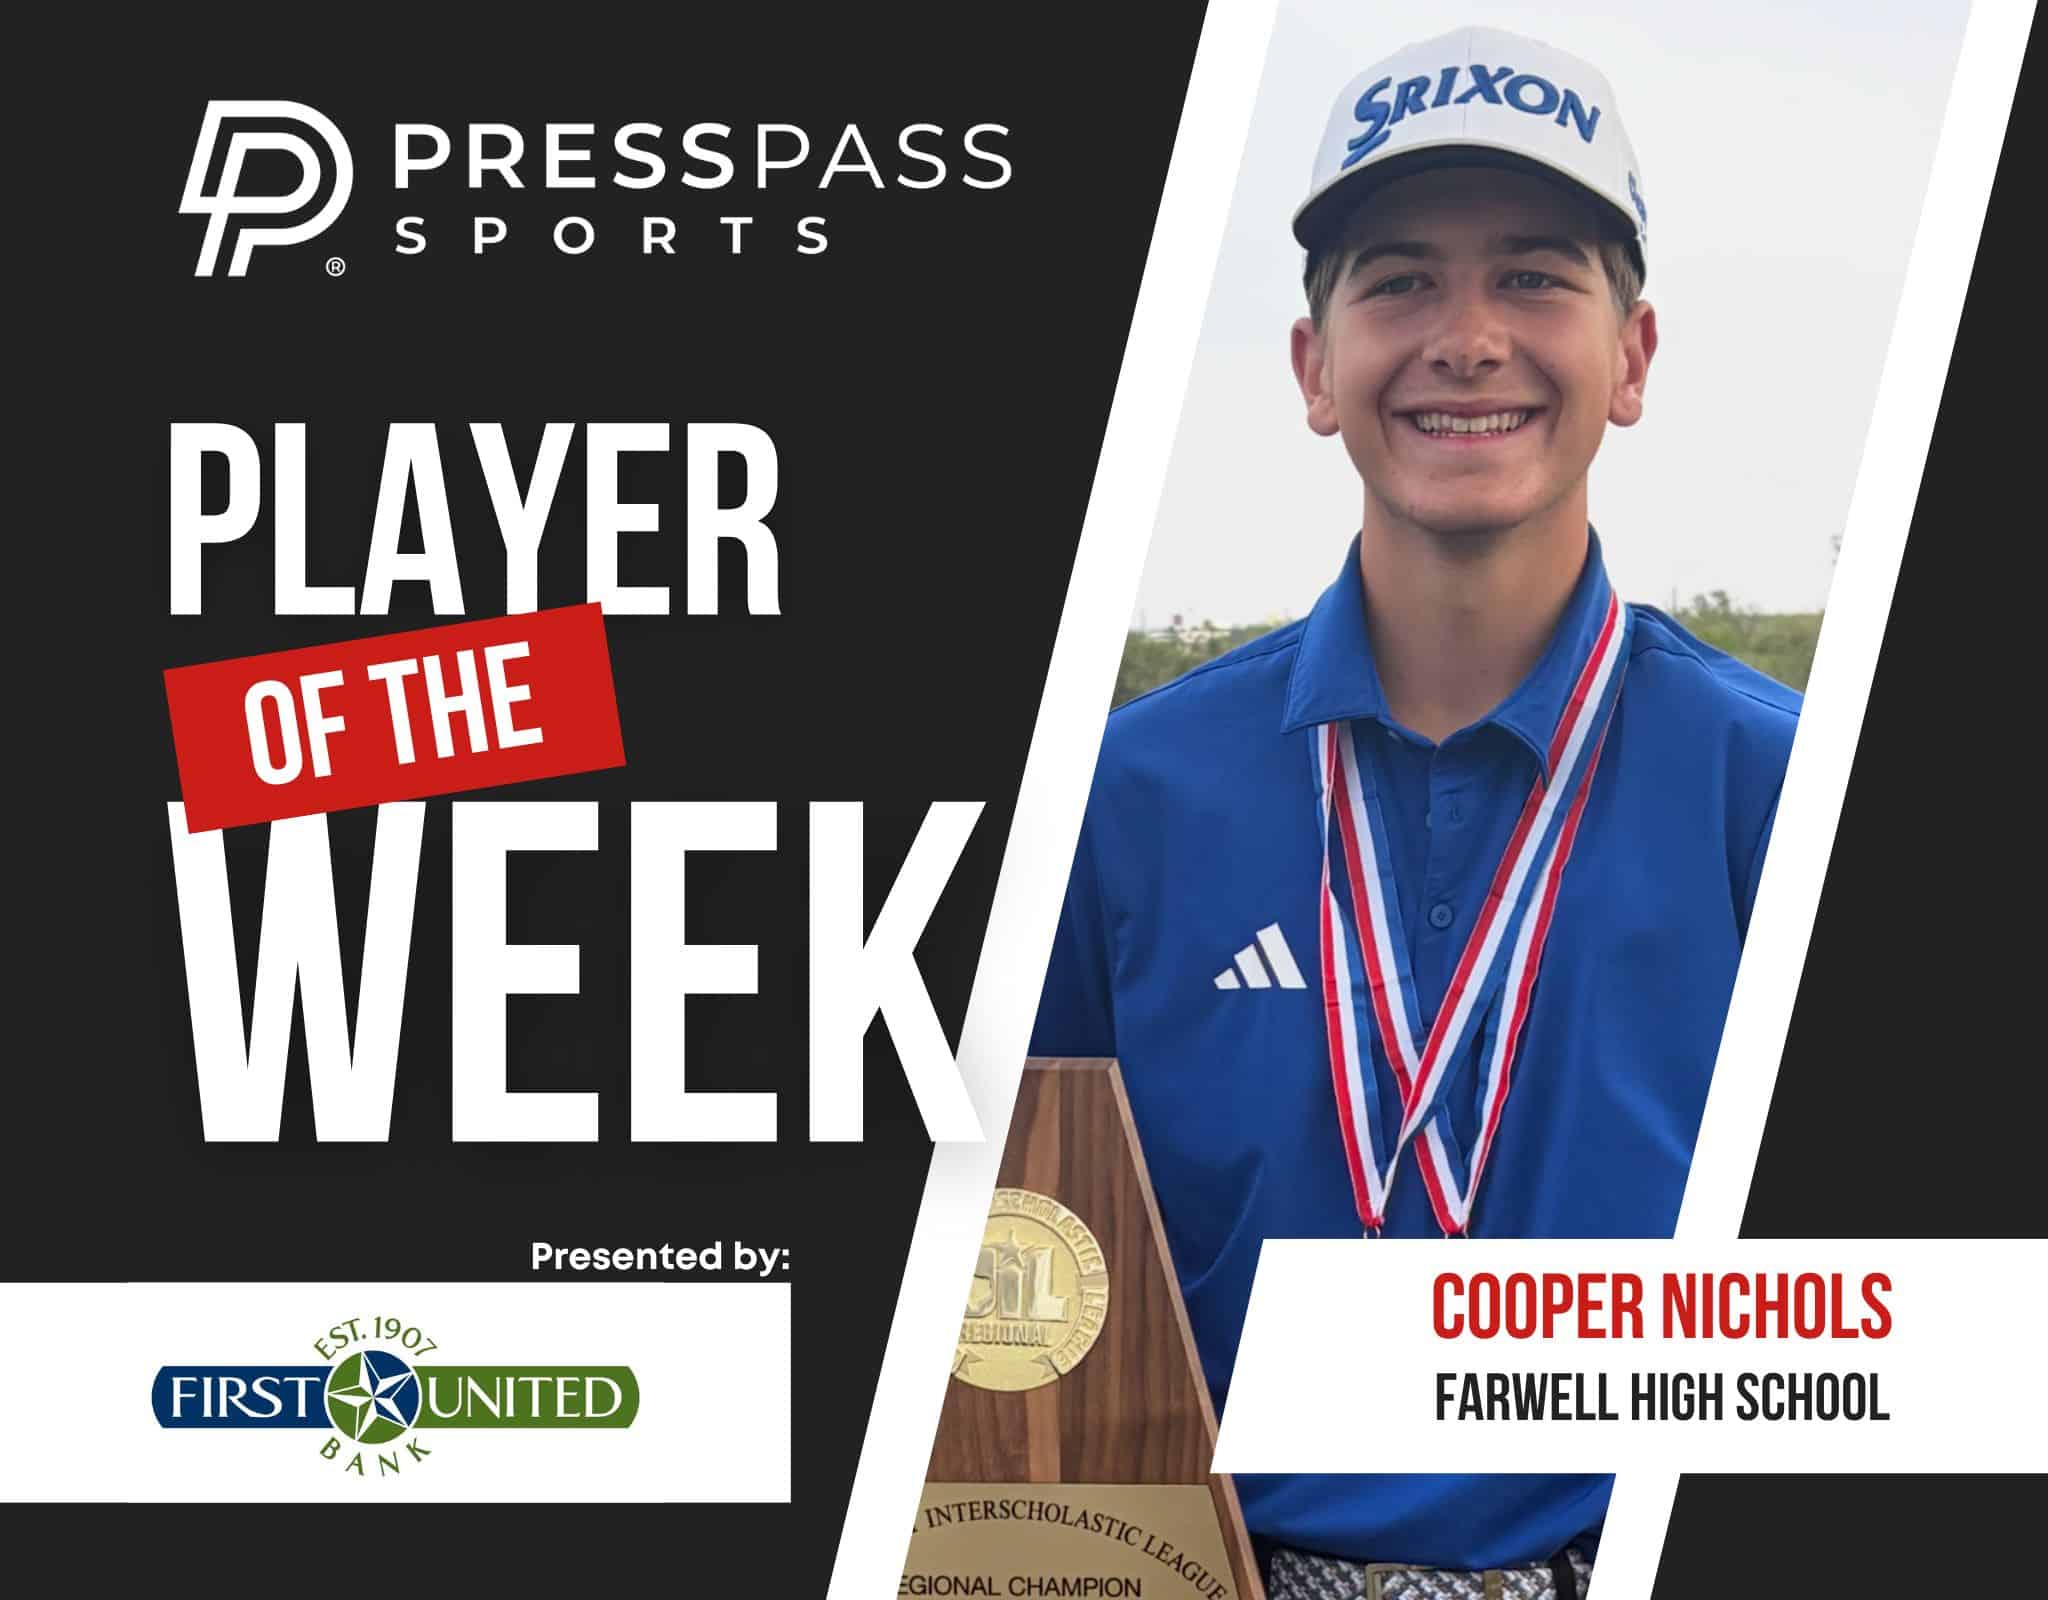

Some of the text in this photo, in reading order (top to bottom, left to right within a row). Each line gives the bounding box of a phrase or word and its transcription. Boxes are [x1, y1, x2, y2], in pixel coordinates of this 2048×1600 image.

[1341, 64, 1601, 170] SRIXON
[897, 1575, 1142, 1598] EGIONAL CHAMPION
[924, 1499, 1228, 1600] INTERSCHOLASTIC LEAGUE
